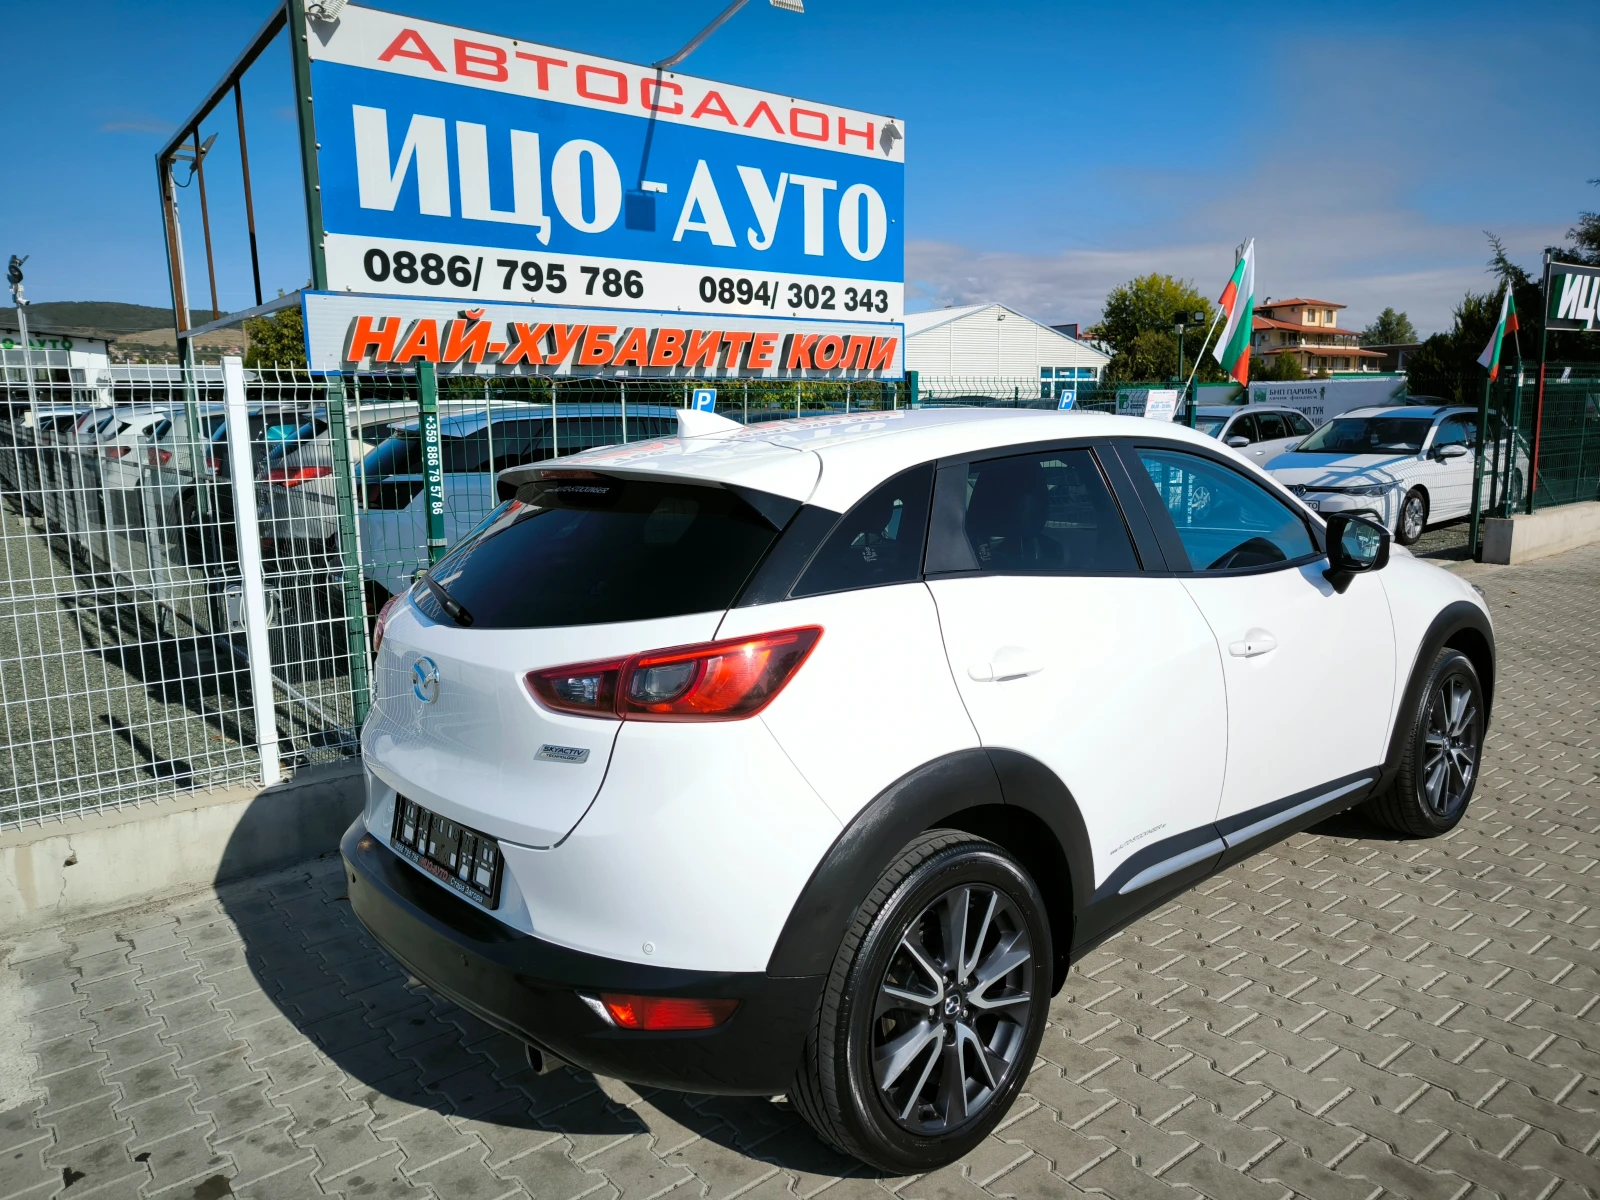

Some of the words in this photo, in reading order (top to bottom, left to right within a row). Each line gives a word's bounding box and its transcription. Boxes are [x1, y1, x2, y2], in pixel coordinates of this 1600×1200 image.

[378, 28, 875, 151] АВТОСАЛОН
[363, 248, 482, 292] 0886/
[498, 260, 567, 294] 795
[581, 266, 644, 300] 786
[699, 275, 780, 310] 0894/
[788, 282, 836, 310] 302
[844, 287, 889, 314] 343
[344, 308, 777, 370] НАЙ-ХУБАВИТЕ
[786, 333, 898, 371] КОЛИ
[1269, 388, 1285, 396] БНП
[1286, 387, 1318, 396] ПАРИБА
[697, 392, 711, 410] P
[1062, 392, 1072, 408] P
[426, 415, 437, 443] +359
[427, 446, 438, 466] 886
[428, 468, 440, 482] 79
[430, 485, 442, 498] 57
[431, 501, 443, 515] 86
[543, 747, 583, 755] SKYACTIV
[450, 877, 465, 891] Стара
